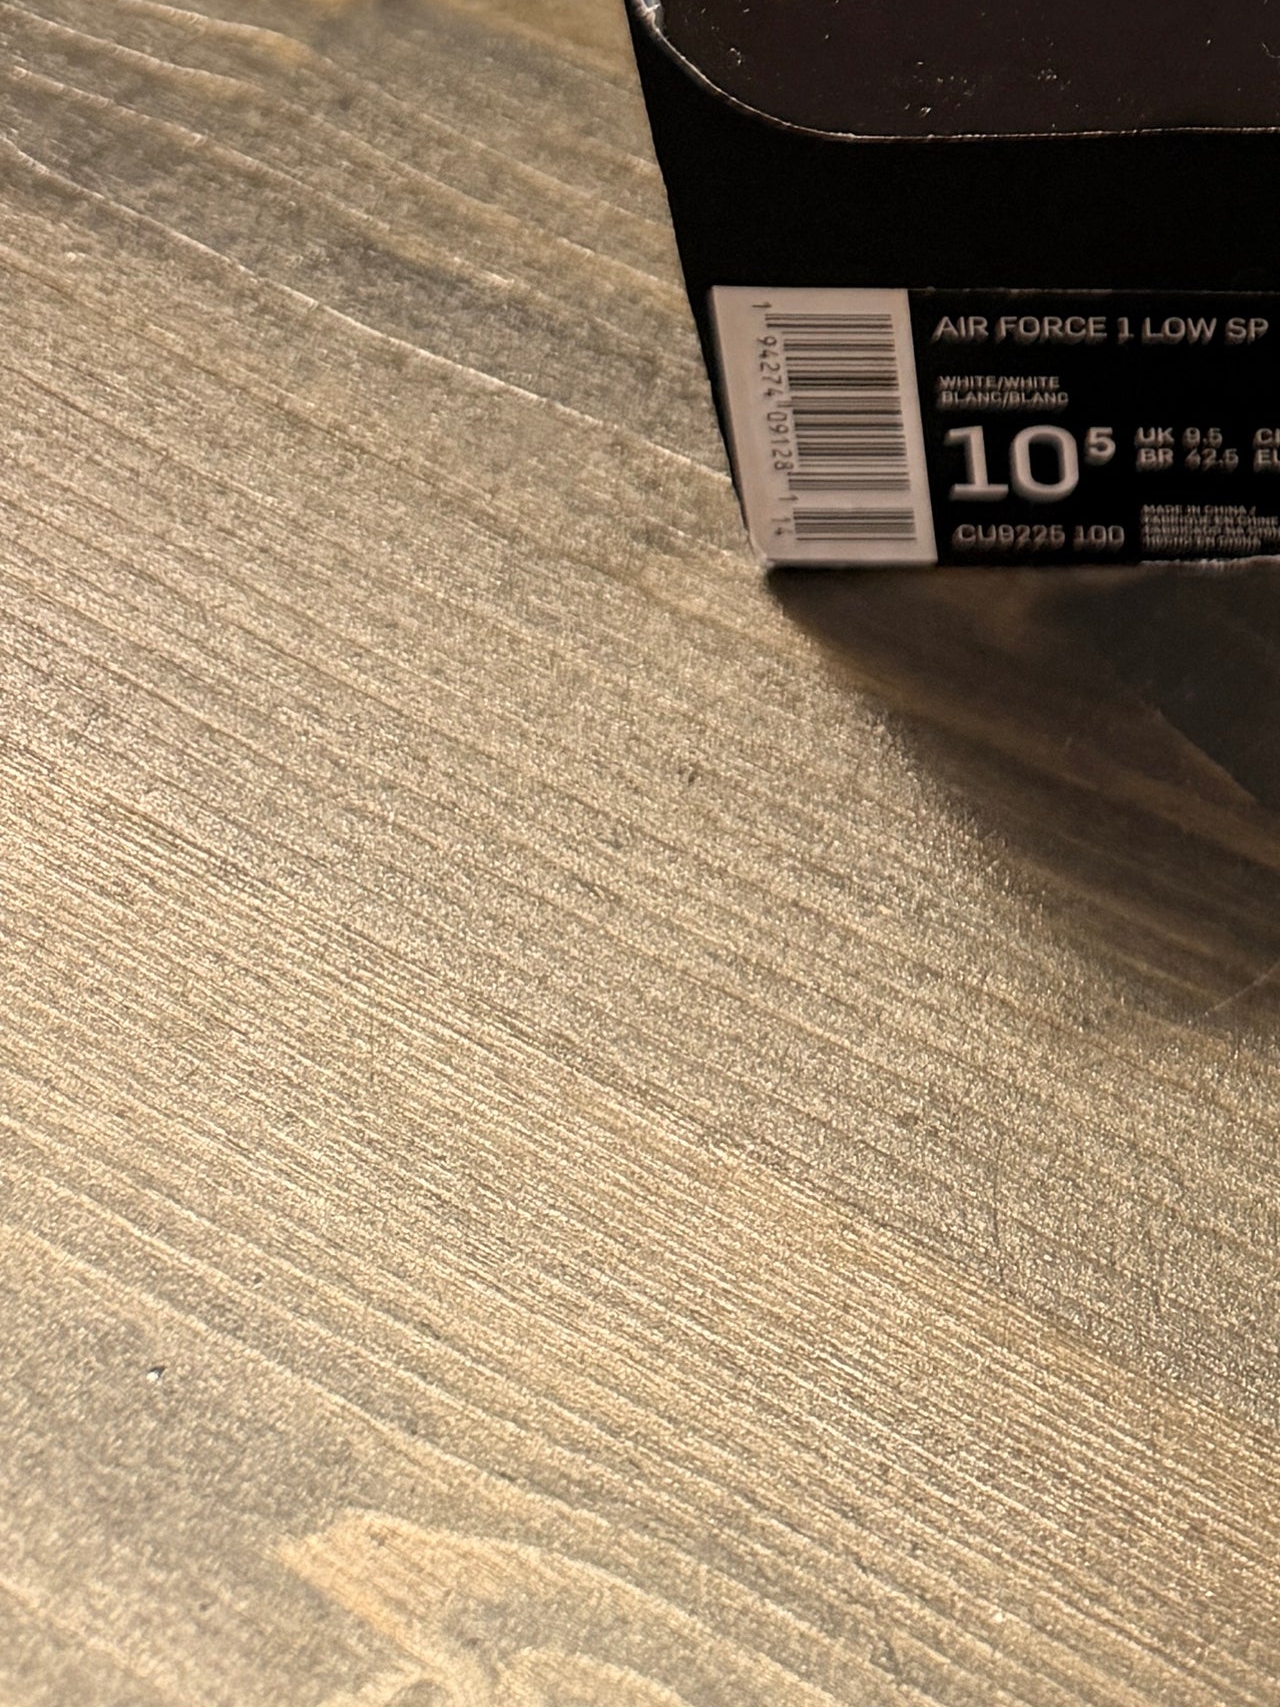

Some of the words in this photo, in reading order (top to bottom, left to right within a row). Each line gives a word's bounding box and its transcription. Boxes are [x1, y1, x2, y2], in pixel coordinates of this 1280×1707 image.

[932, 316, 988, 341] AIR
[996, 316, 1107, 342] FORCE
[1118, 317, 1134, 342] 1
[1142, 317, 1217, 343] LOW
[1225, 317, 1269, 344] SP
[757, 336, 784, 398] 94274
[938, 375, 1060, 391] WHITE/WHITE
[938, 391, 1069, 410] BLANC/BLANC
[766, 411, 795, 472] 09128
[1134, 427, 1174, 447] UK
[1136, 448, 1174, 472] BR
[1183, 448, 1239, 473] 42.5
[951, 523, 1066, 551] CU9225
[1073, 524, 1125, 551] 100
